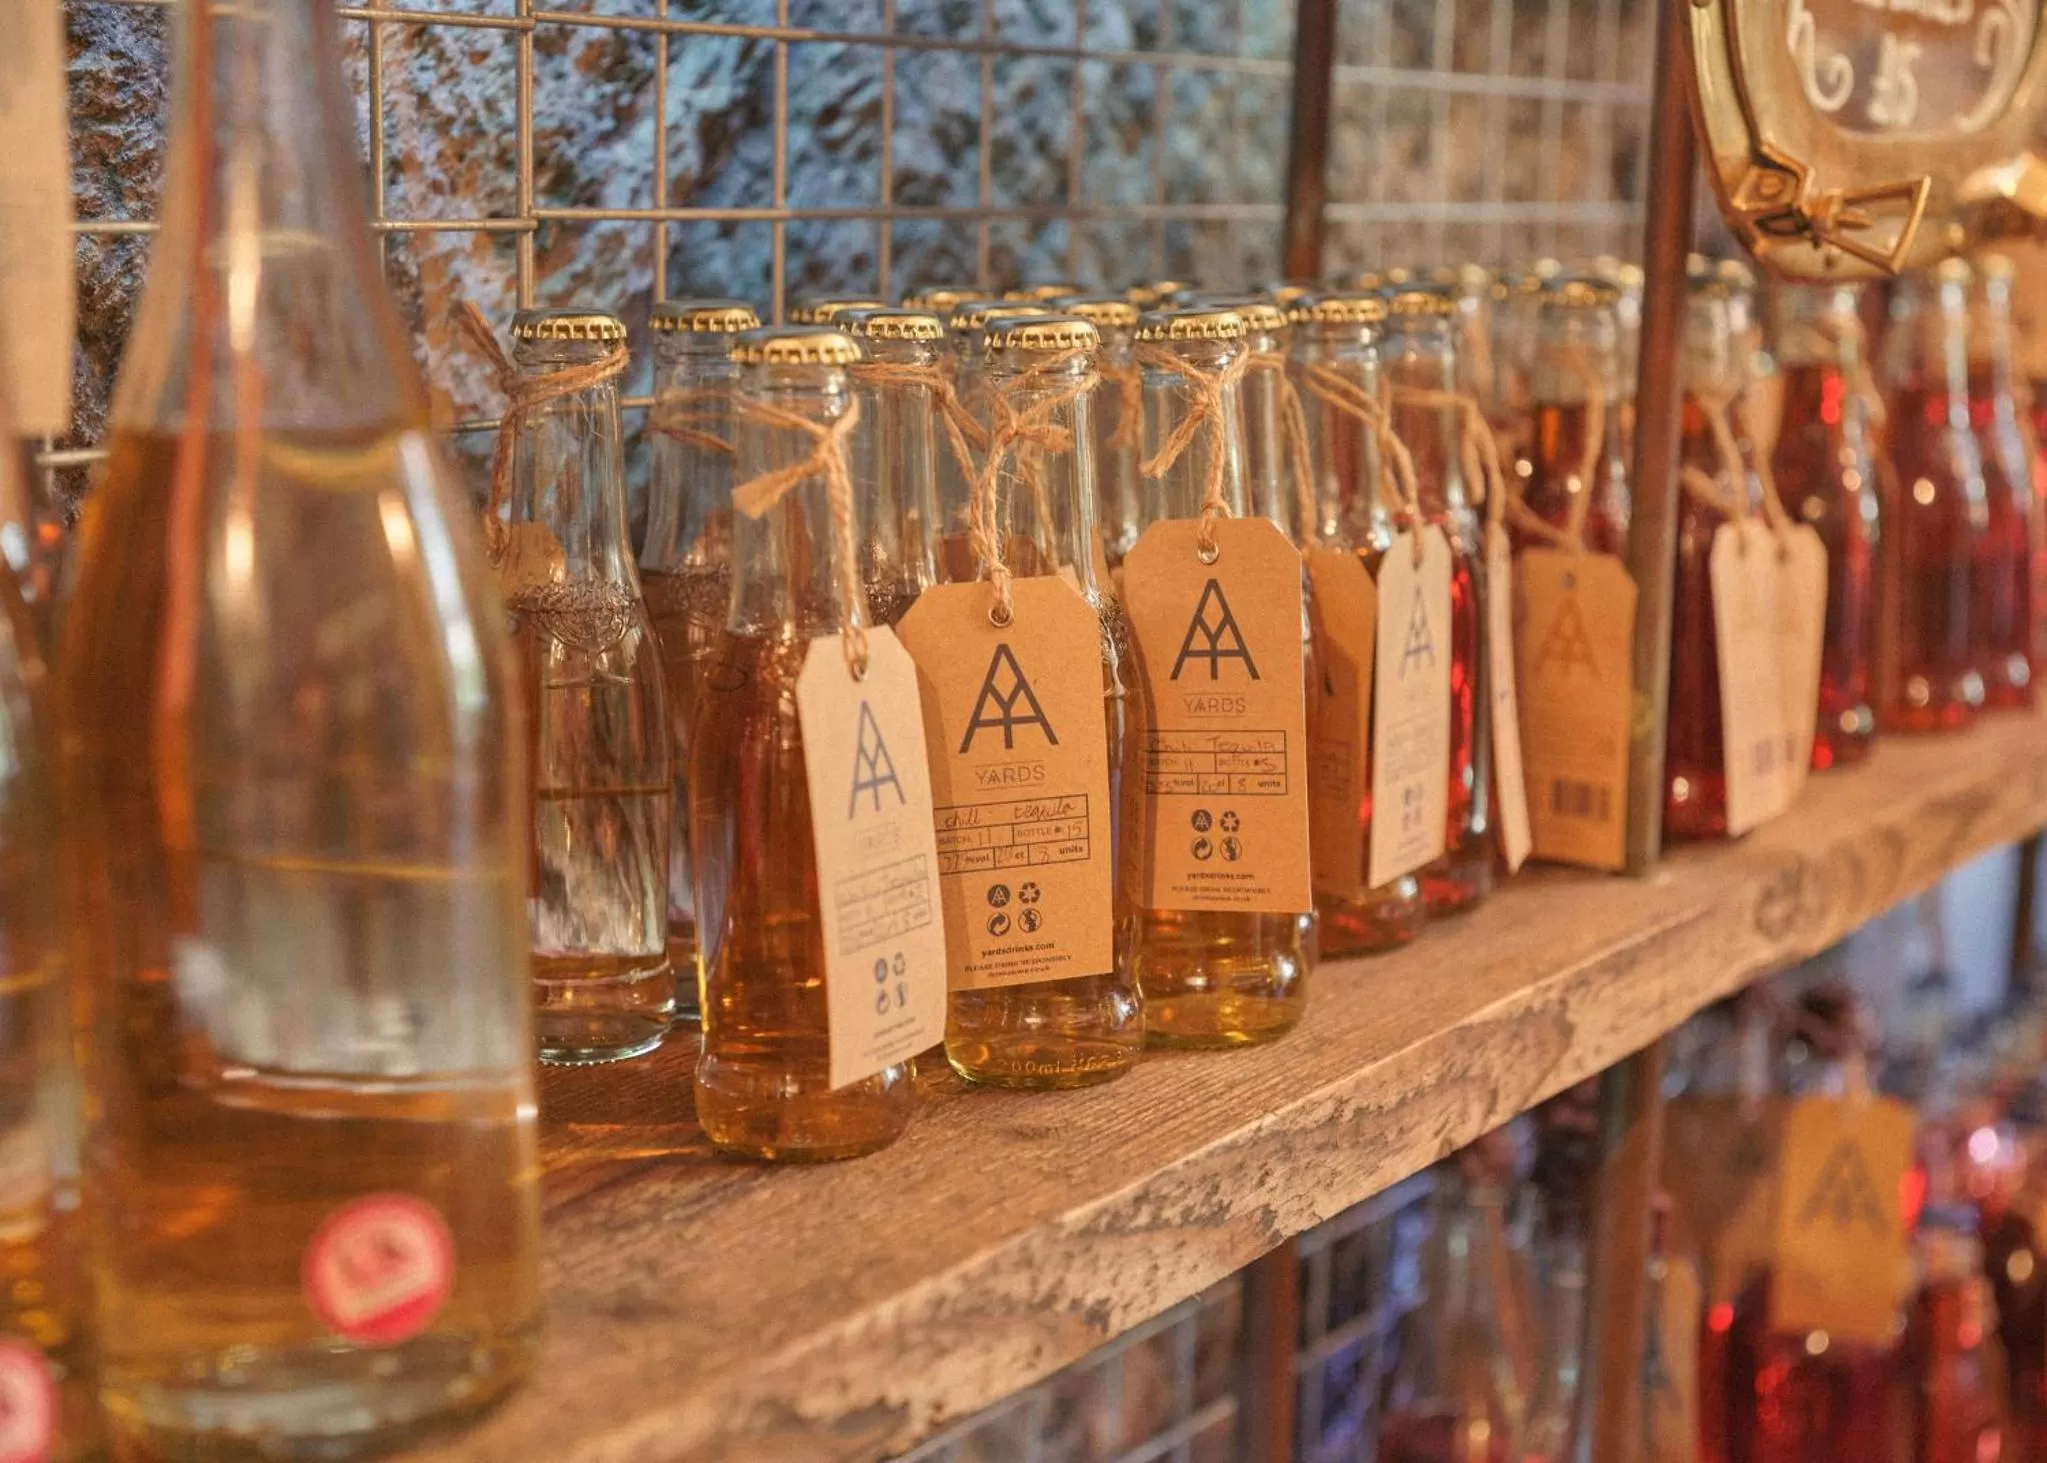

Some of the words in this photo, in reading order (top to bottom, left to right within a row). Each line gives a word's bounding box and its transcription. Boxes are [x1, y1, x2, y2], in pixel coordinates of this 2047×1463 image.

[1183, 697, 1247, 715] YARDS
[974, 765, 1047, 786] YARDS
[981, 942, 1055, 959] yardsdrinks.com
